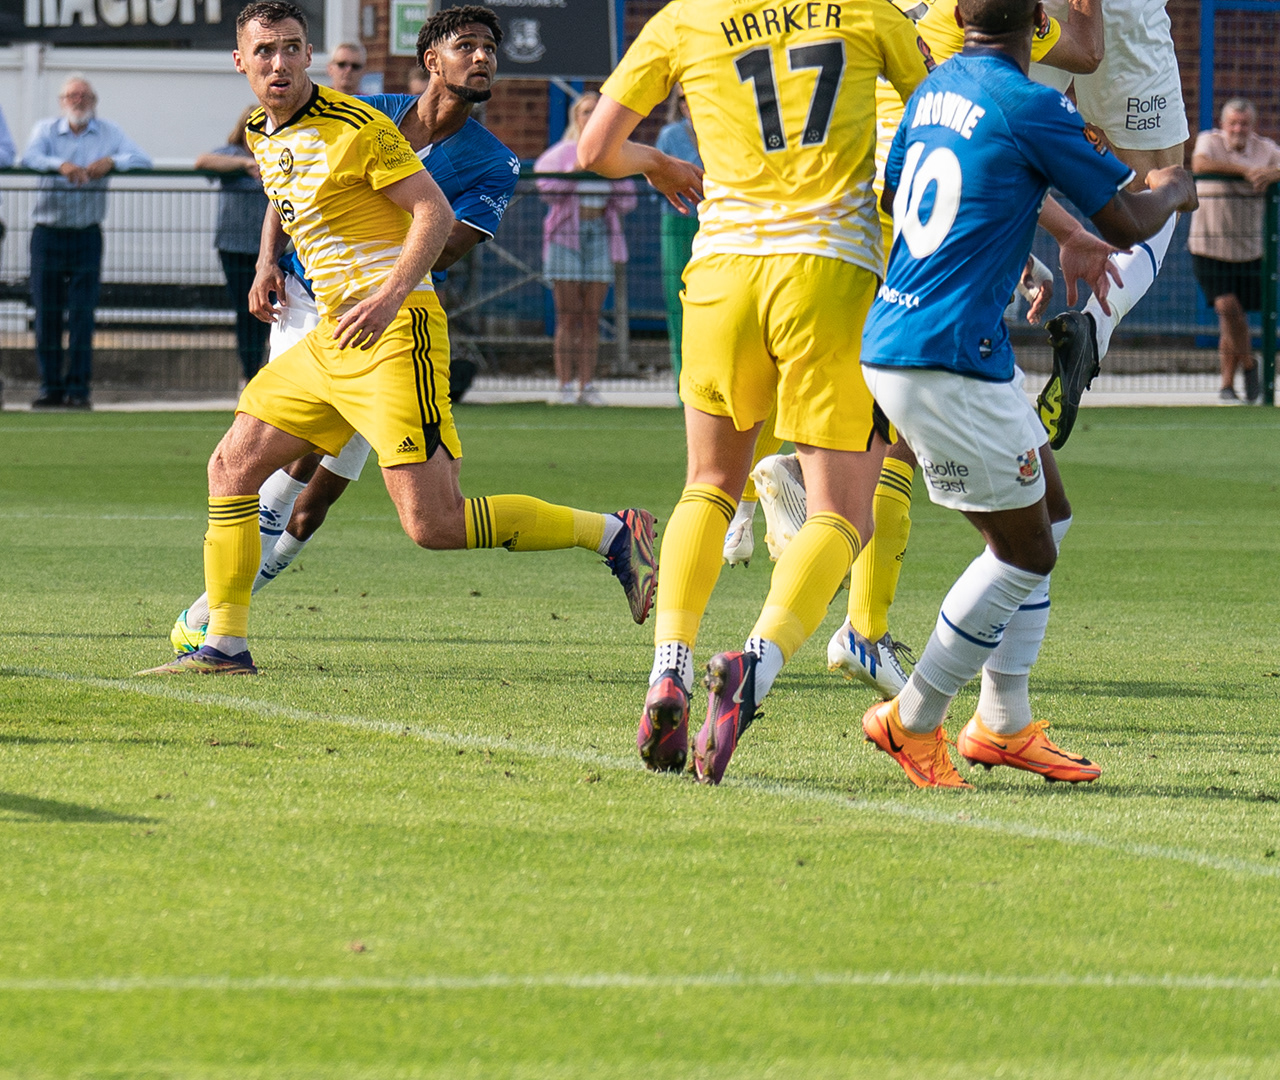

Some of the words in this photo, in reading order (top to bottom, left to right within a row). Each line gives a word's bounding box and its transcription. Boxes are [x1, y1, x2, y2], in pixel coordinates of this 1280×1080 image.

[720, 2, 842, 47] HARKER
[733, 37, 847, 155] 17
[1127, 95, 1167, 114] Rolfe
[911, 91, 986, 140] BROWNE
[1125, 114, 1161, 131] East
[893, 141, 962, 259] 10
[923, 457, 969, 477] Rolfe
[930, 475, 967, 494] East
